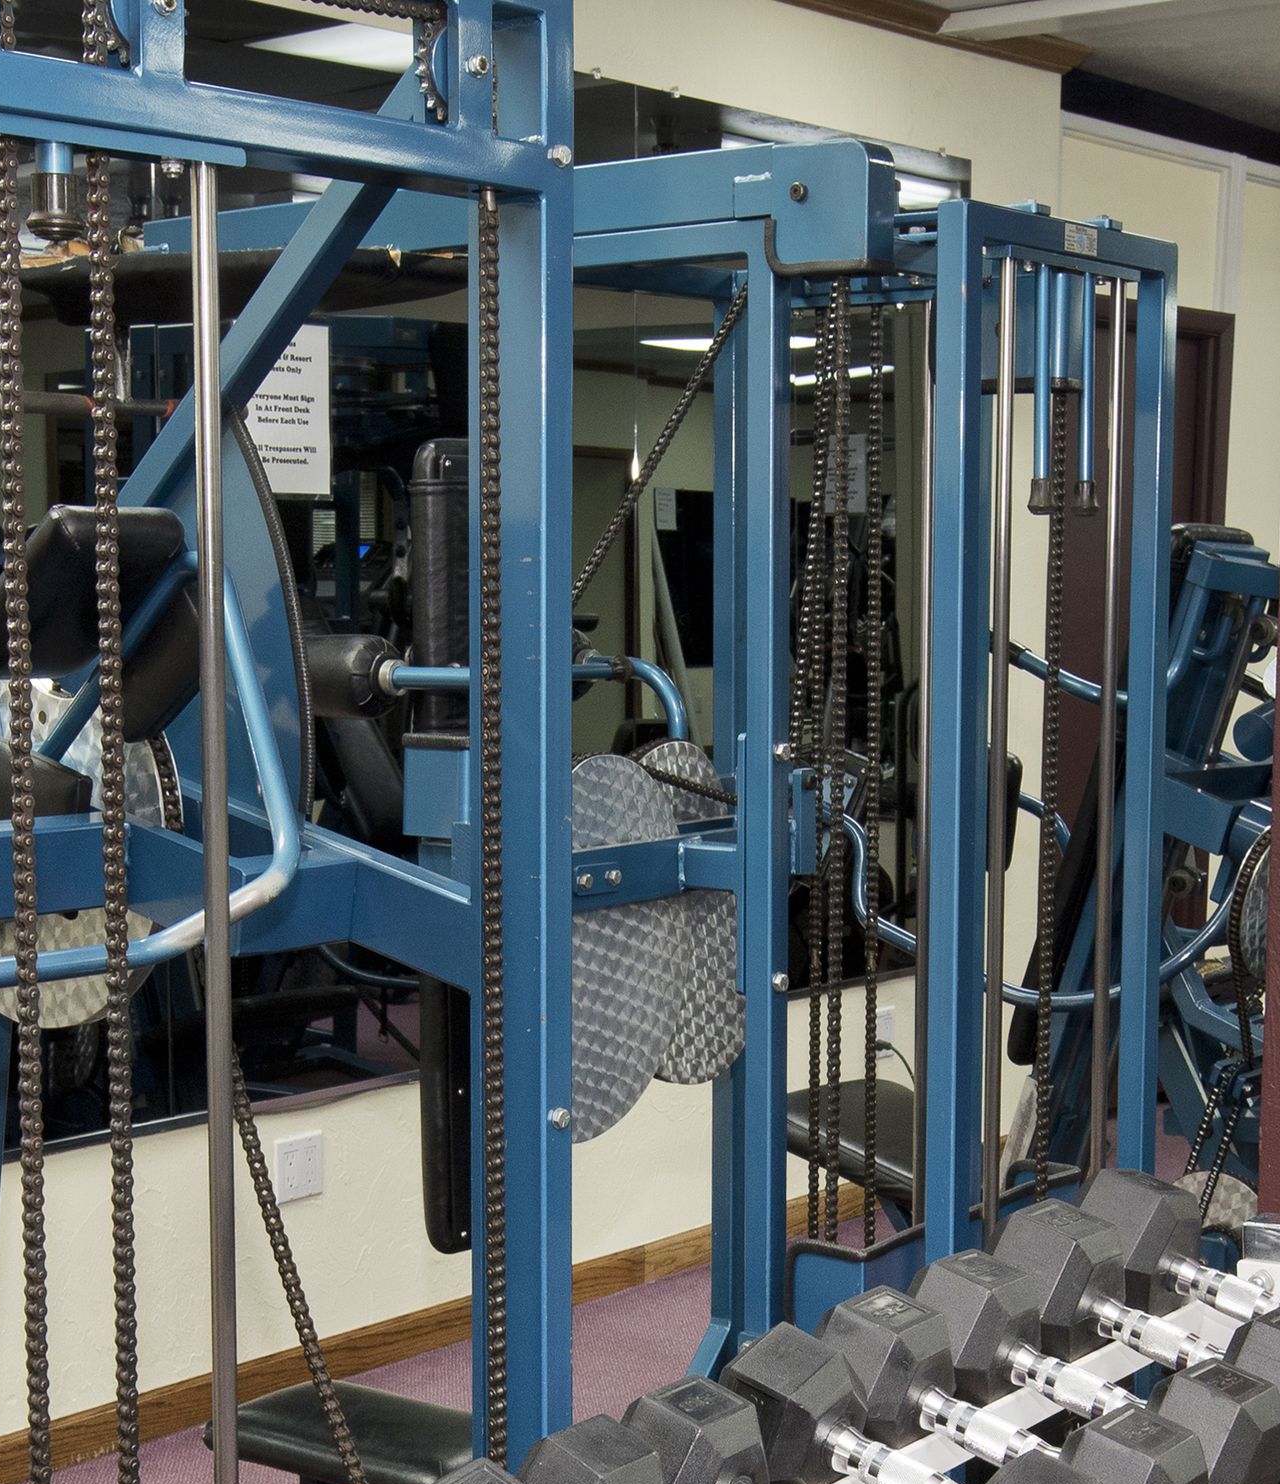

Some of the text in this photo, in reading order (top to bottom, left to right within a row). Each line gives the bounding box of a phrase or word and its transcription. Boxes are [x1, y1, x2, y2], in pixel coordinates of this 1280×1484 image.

[290, 354, 312, 363] Resort
[286, 366, 302, 374] Only
[253, 392, 282, 400] veryone
[300, 394, 315, 403] Sign
[274, 405, 293, 413] Front
[294, 406, 310, 414] Desk
[257, 416, 309, 426] Before Each Use
[264, 444, 302, 453] Trespassers
[303, 446, 317, 454] Will
